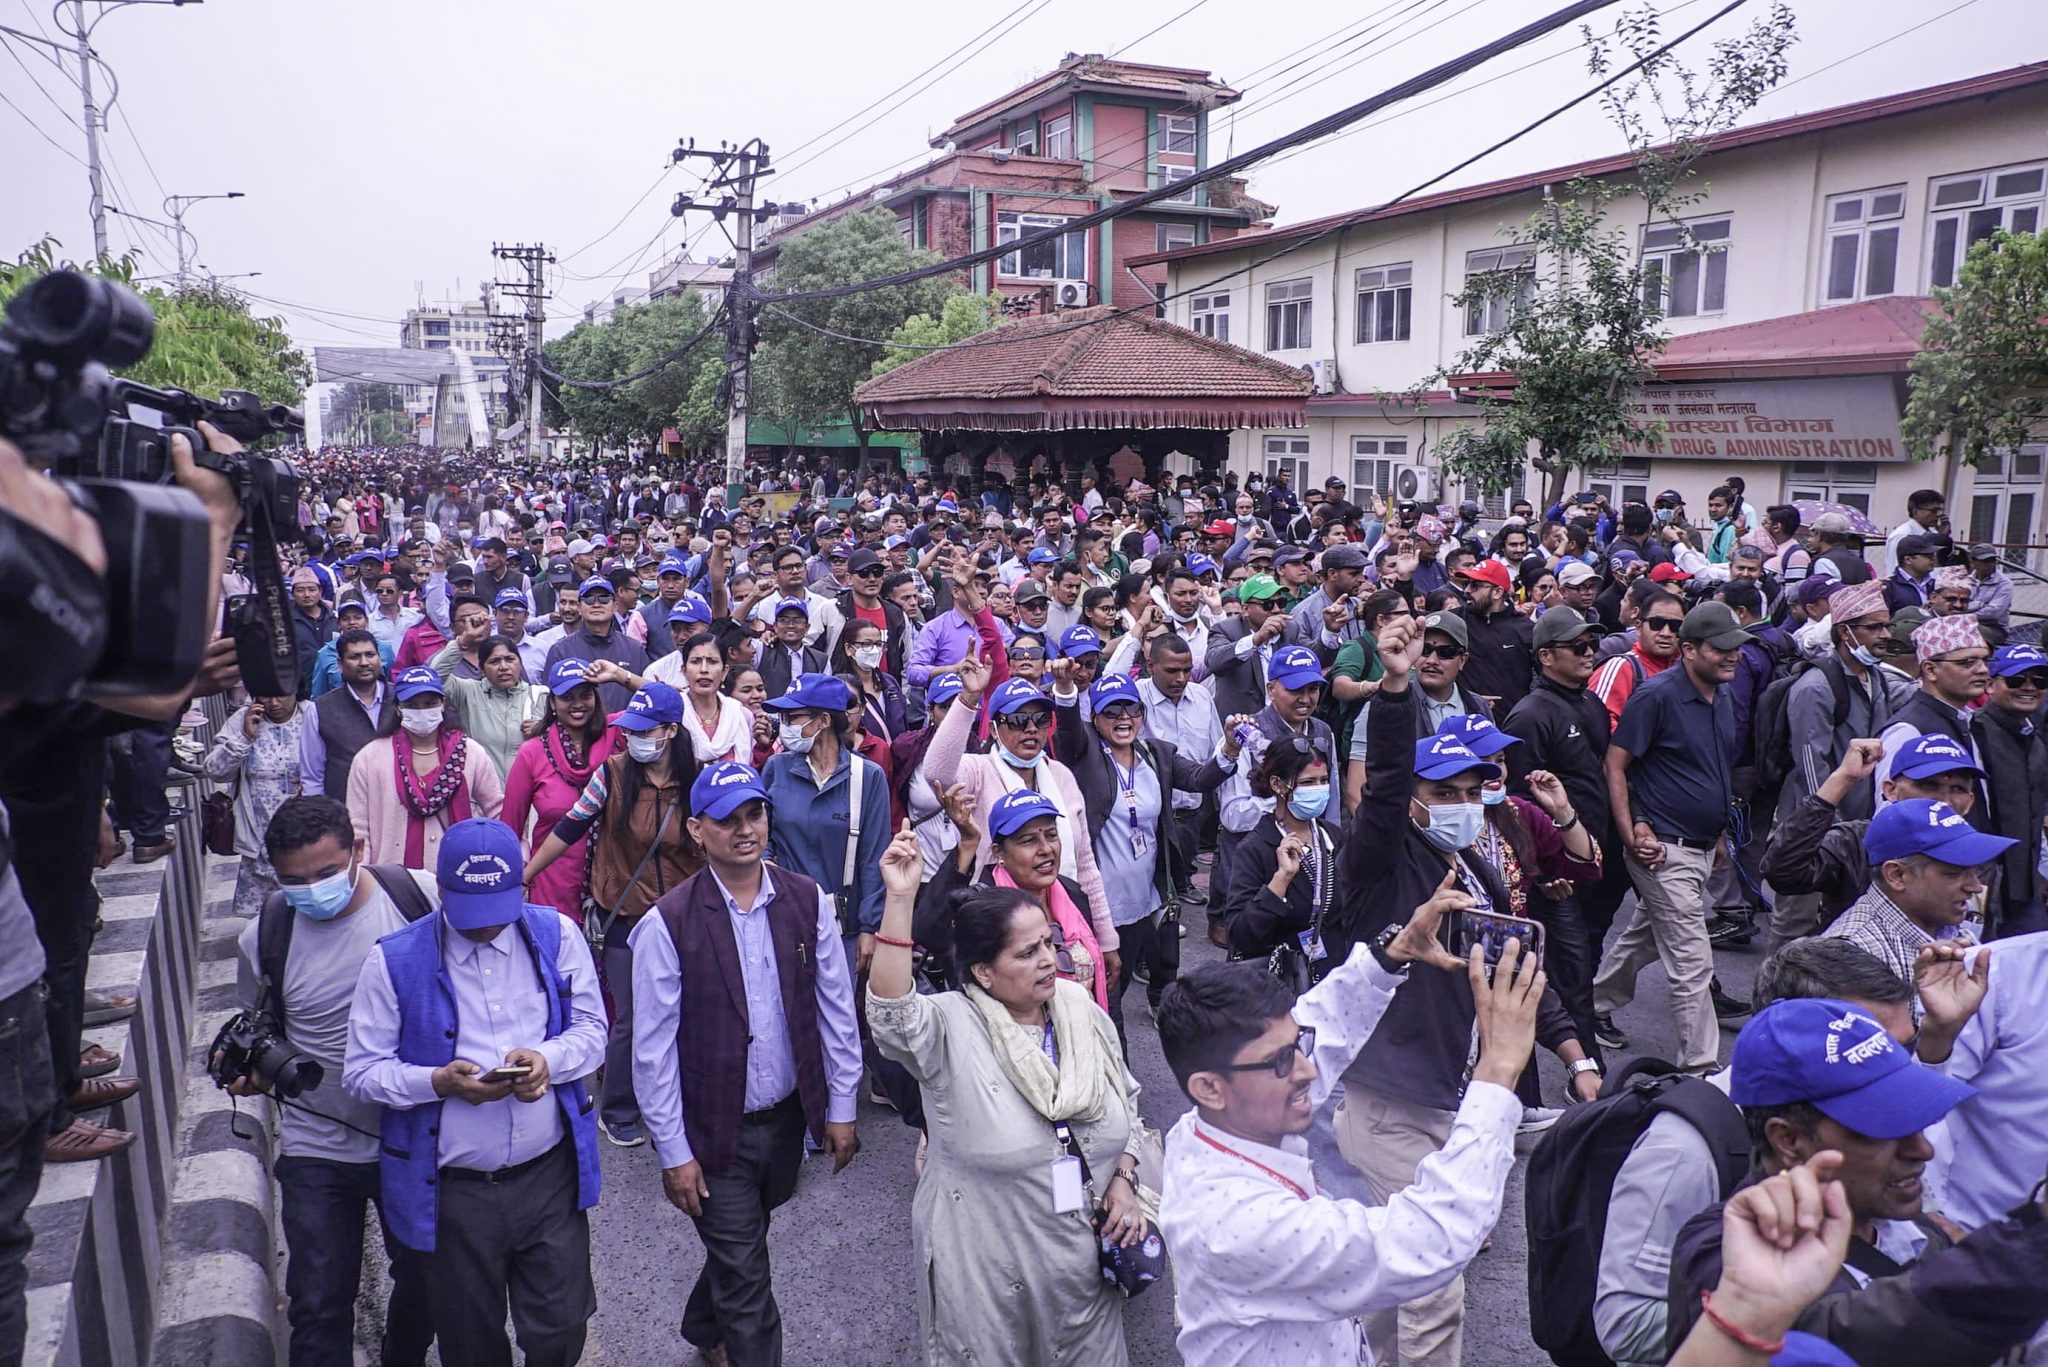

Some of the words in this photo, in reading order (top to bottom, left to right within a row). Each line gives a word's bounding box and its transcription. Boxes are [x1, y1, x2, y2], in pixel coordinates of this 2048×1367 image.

[1676, 389, 1717, 400] सरकार
[1716, 402, 1757, 416] मन्त्रालय
[1744, 415, 1834, 434] विभाग
[1670, 438, 1716, 456] DRUG
[1726, 438, 1894, 457] ADMINISTRATION
[464, 871, 503, 887] नवलपुर
